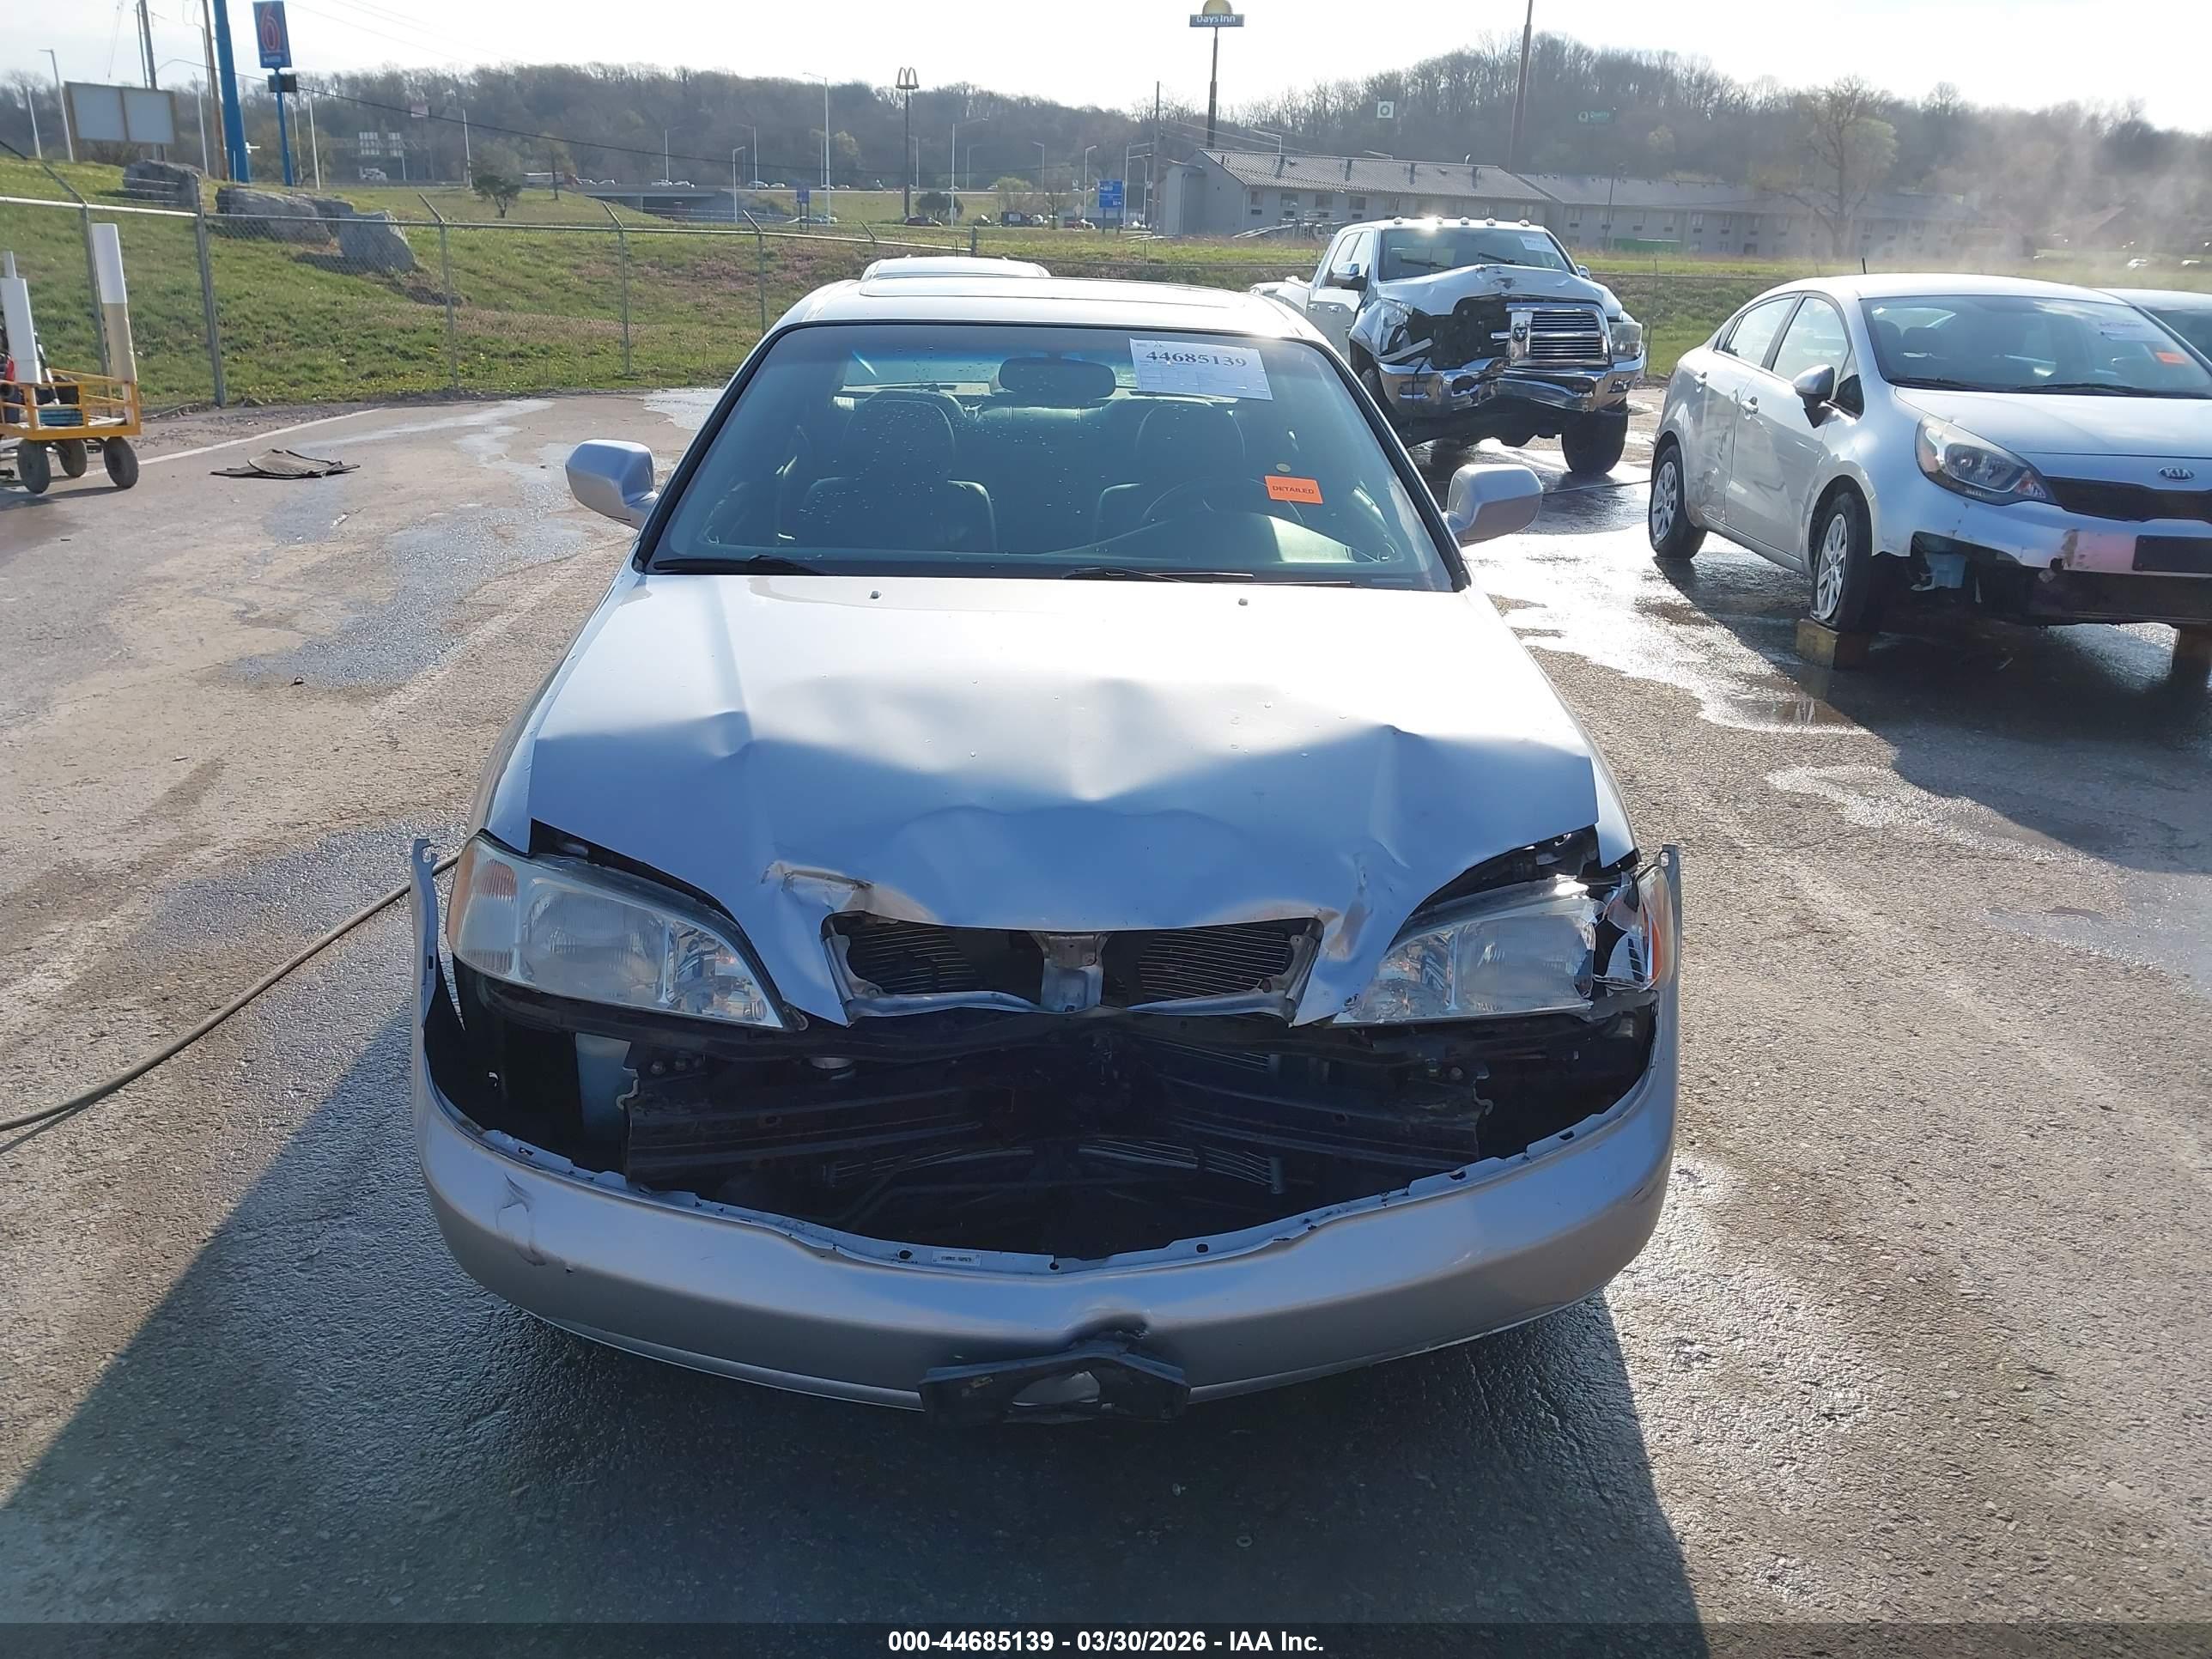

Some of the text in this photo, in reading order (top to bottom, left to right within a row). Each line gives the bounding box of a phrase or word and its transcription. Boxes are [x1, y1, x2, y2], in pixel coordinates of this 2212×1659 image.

[1196, 14, 1237, 24] Days Inn
[1146, 350, 1248, 368] 44685139
[2165, 468, 2193, 478] KIA
[1272, 485, 1315, 495] DETAILED
